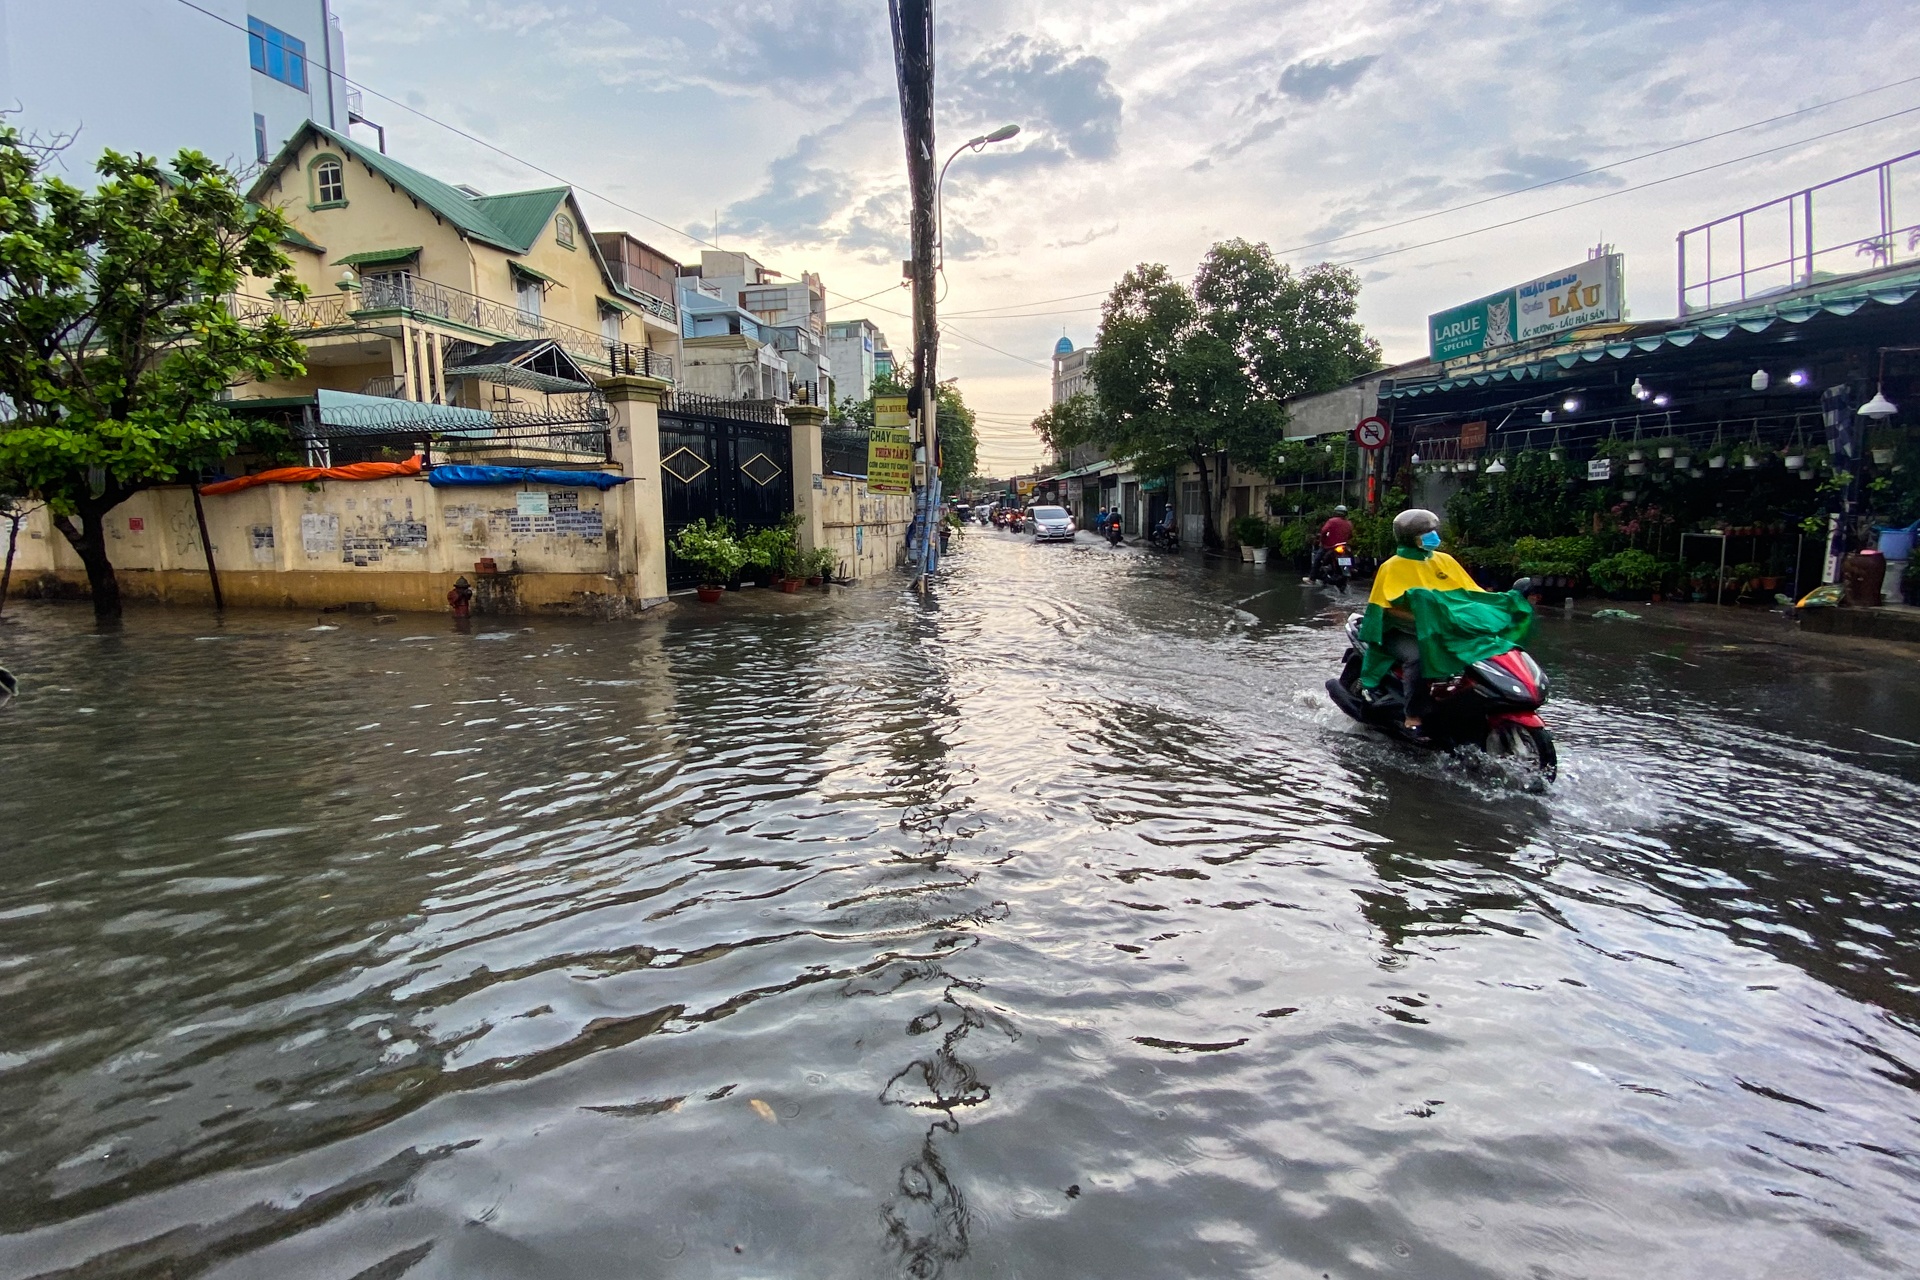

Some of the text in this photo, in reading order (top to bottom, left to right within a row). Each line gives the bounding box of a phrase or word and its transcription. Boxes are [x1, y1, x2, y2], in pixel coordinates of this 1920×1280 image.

[1435, 316, 1480, 341] LARUE
[1443, 339, 1472, 352] SPECIAL
[870, 430, 891, 442] CHAY
